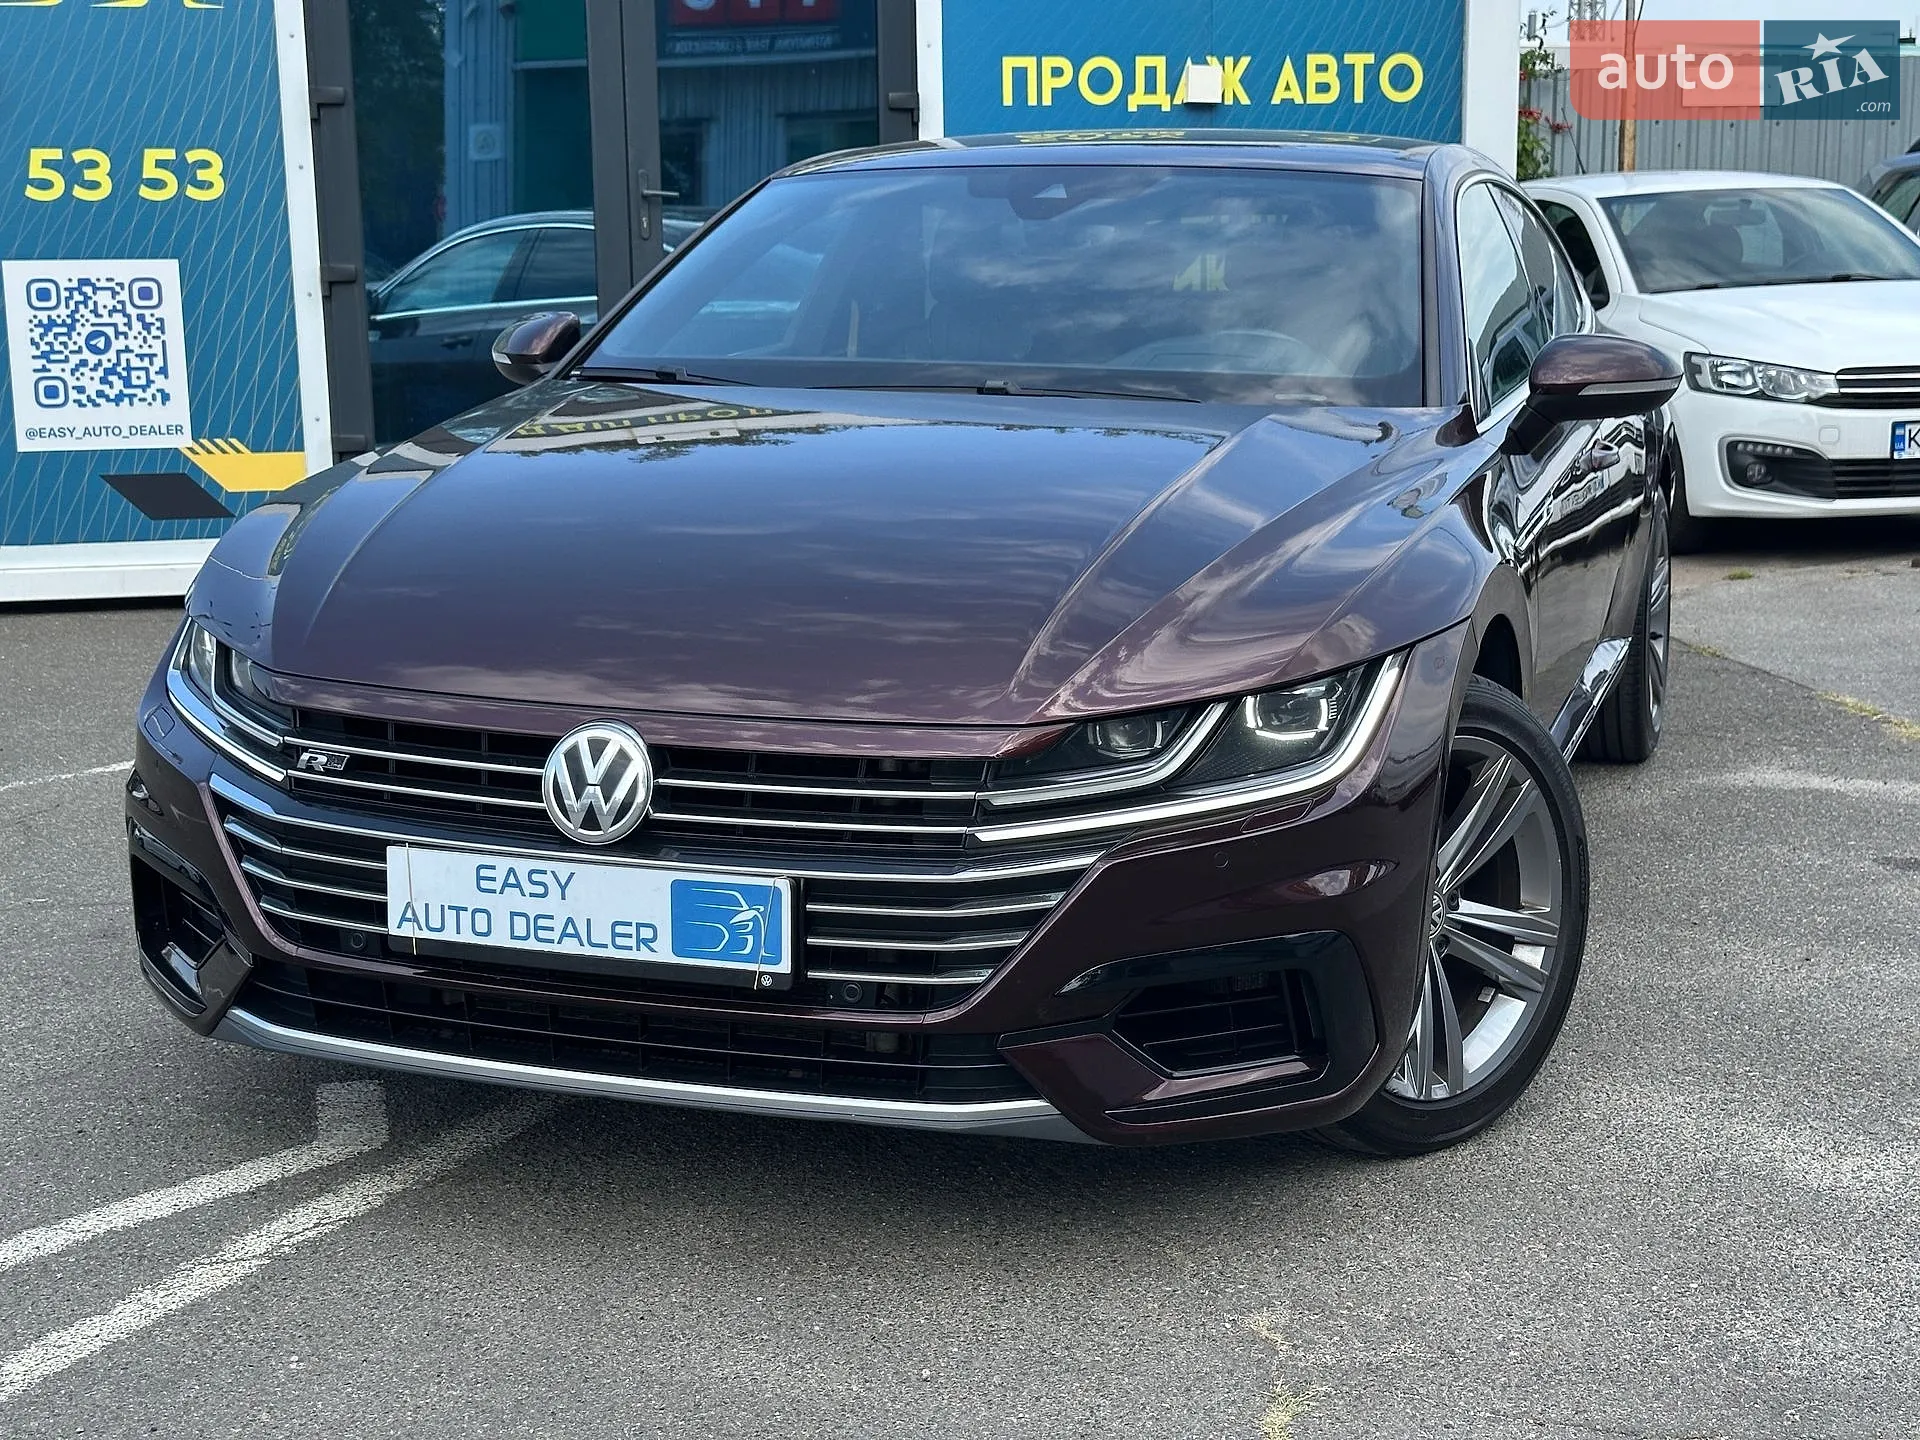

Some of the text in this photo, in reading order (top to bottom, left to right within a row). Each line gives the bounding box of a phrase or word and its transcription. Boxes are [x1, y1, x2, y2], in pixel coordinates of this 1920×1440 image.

[1271, 53, 1425, 105] АВТО
[24, 148, 226, 202] 53 53
[25, 424, 184, 441] @EASY_AUTO_DEALER
[475, 864, 576, 901] EASY
[397, 901, 659, 953] AUTO DEALER
